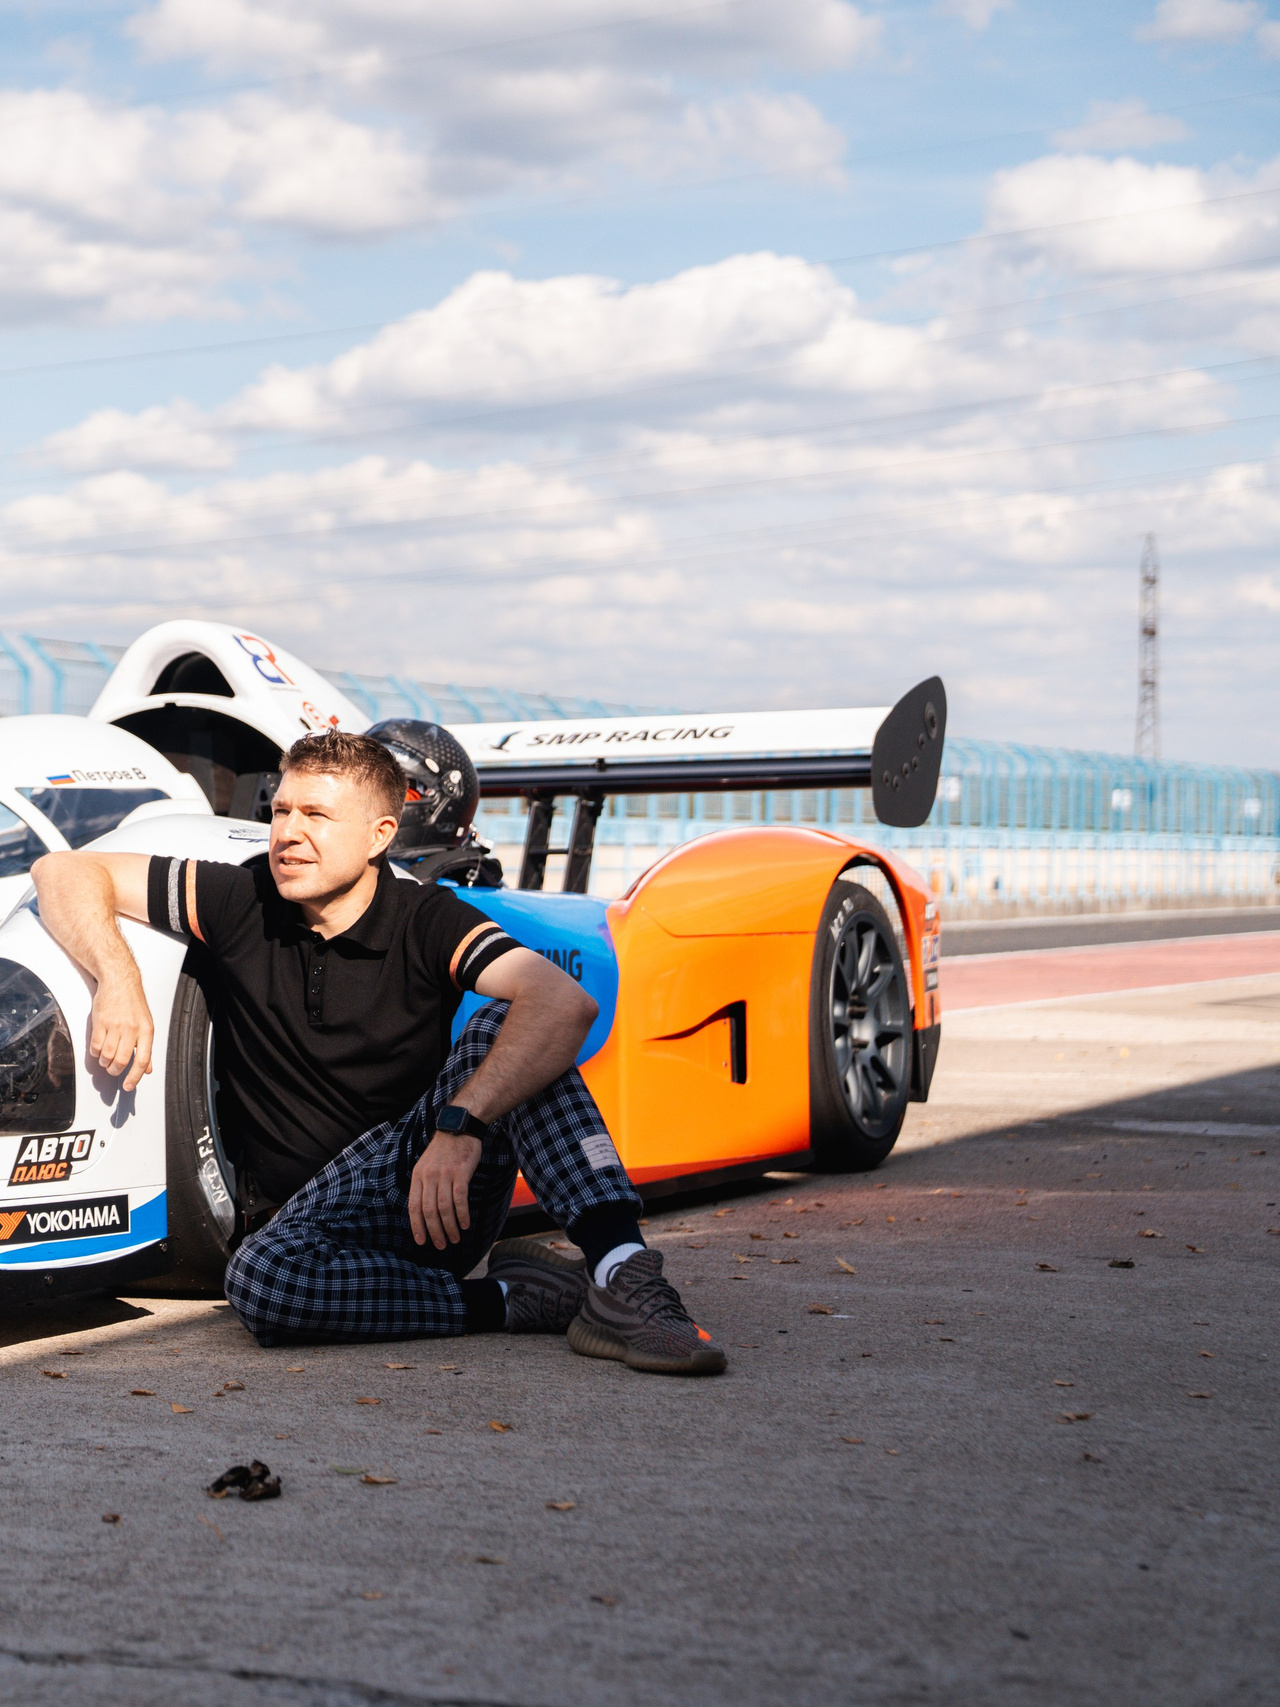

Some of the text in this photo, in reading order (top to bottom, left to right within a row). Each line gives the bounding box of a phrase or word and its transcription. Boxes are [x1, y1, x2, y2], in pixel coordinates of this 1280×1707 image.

[527, 726, 735, 746] SMP RACING
[71, 769, 132, 784] Петров
[18, 1133, 92, 1164] АВТО
[12, 1161, 68, 1183] ПЛЮС
[26, 1204, 120, 1234] YOKOHAMA
